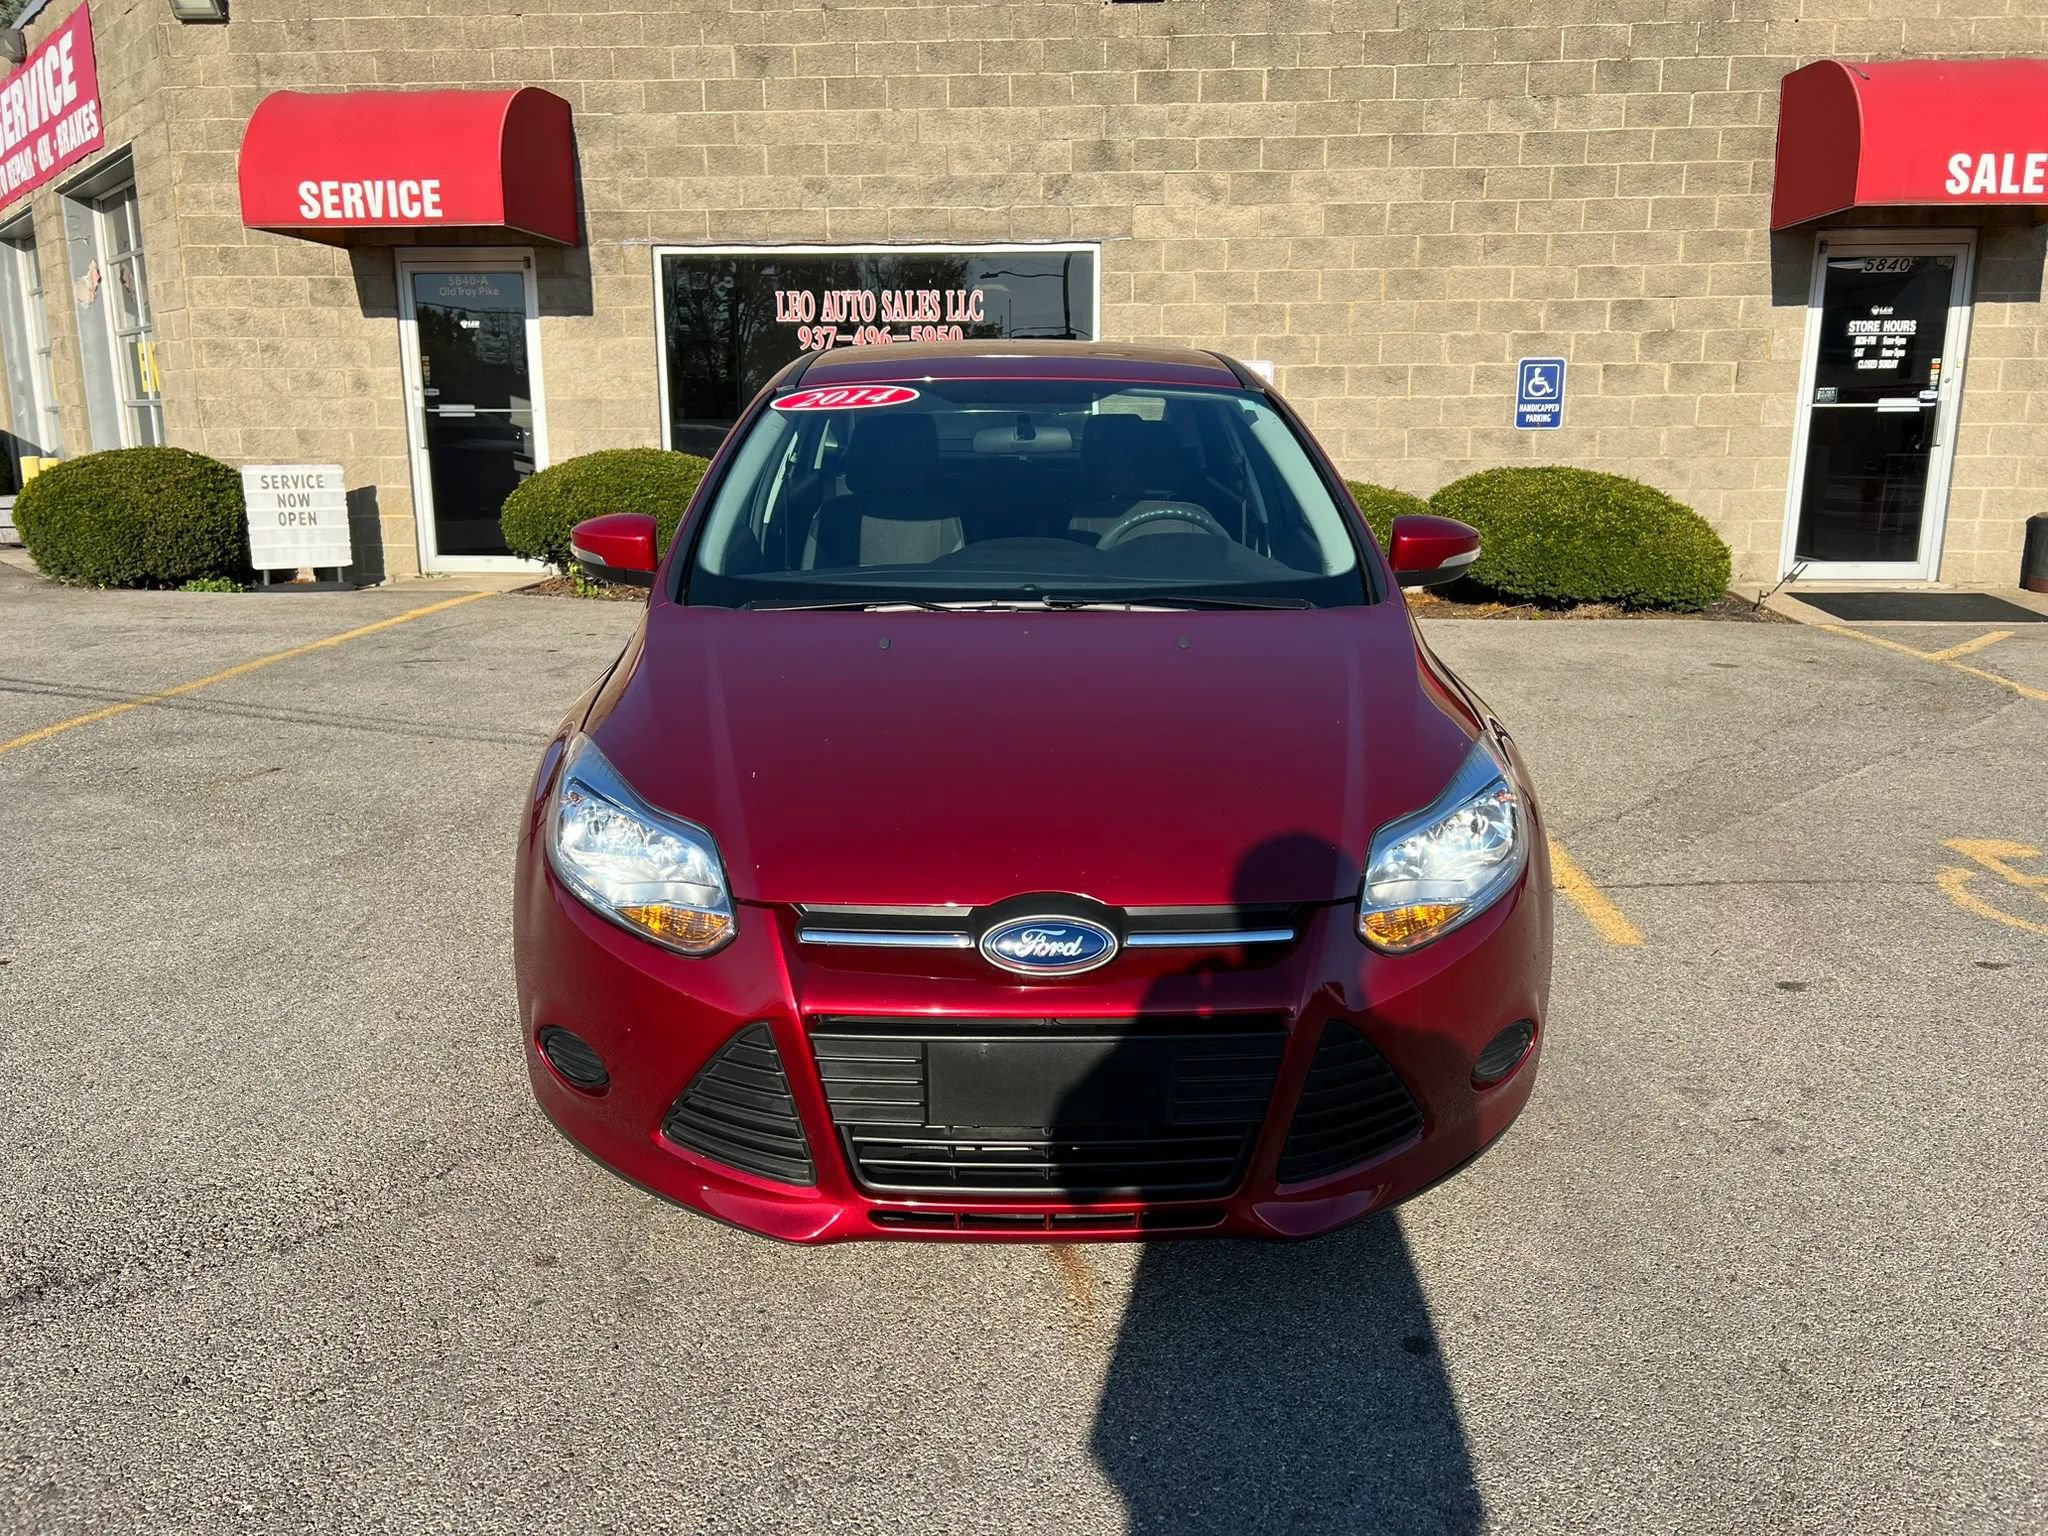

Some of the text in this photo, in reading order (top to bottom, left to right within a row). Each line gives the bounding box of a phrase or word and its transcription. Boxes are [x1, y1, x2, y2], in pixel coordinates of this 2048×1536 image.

[0, 30, 77, 158] ERVICE
[6, 146, 36, 191] REPAIR
[37, 132, 55, 173] OIL
[55, 99, 99, 160] BRAKES
[298, 179, 443, 219] SERVICE
[1864, 258, 1911, 272] 5840
[448, 275, 489, 286] 5840-A
[439, 286, 500, 298] Old Troy Pike
[775, 290, 984, 322] LEO AUTO SALES LLC
[1848, 320, 1917, 332] STORE HOURS
[798, 325, 963, 350] 937-496-5950
[791, 388, 901, 408] 2014
[1518, 403, 1560, 412] HANDICAPPED
[1525, 413, 1552, 423] PARKING
[260, 474, 325, 489] SERVICE
[277, 493, 310, 508] NOW
[278, 511, 317, 526] OPEN
[1014, 928, 1083, 958] Ford
